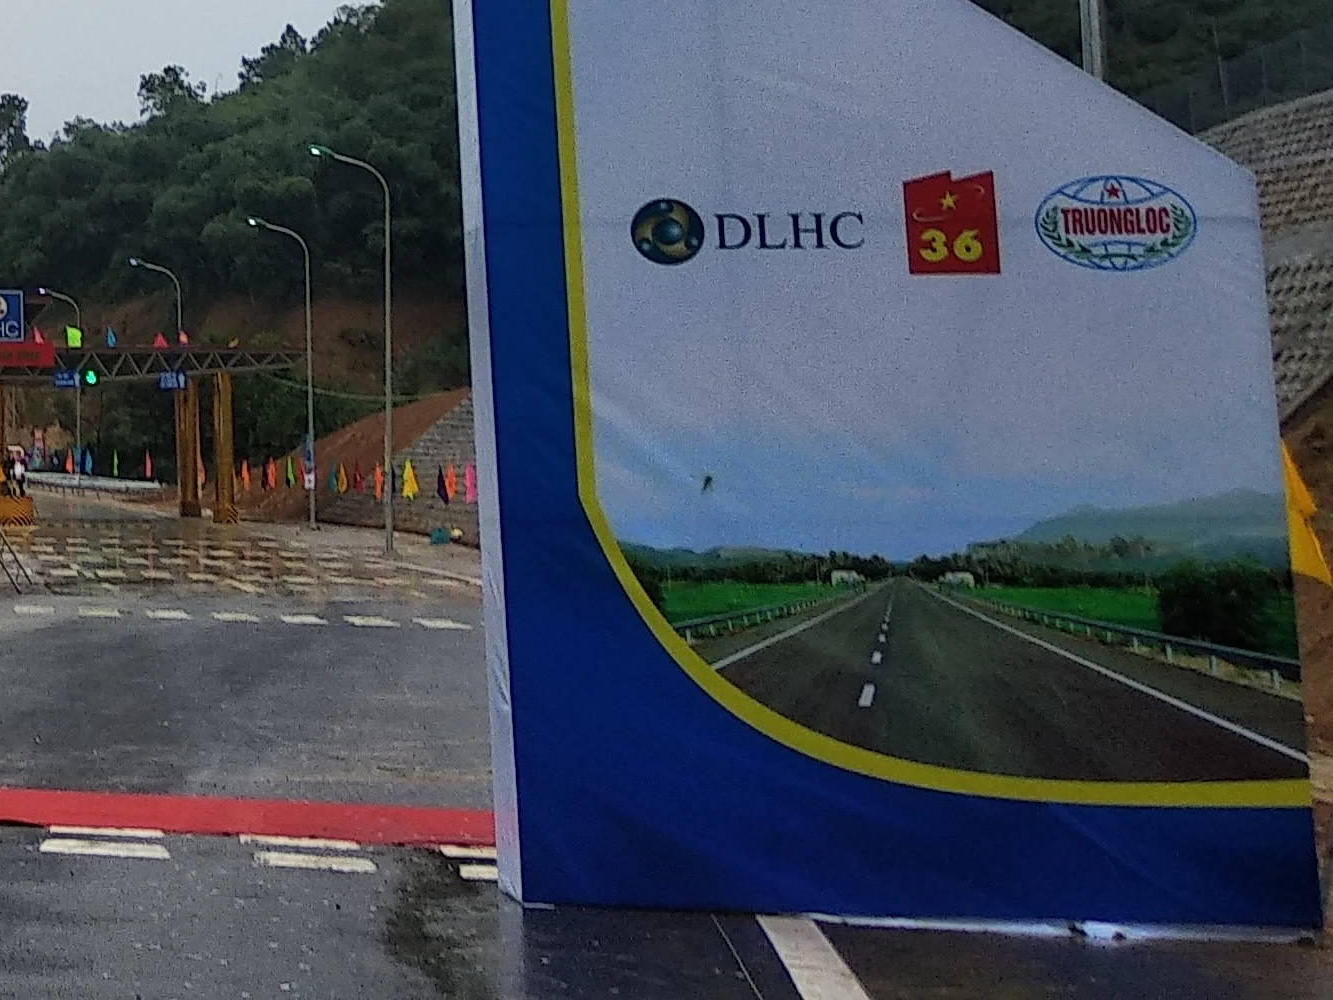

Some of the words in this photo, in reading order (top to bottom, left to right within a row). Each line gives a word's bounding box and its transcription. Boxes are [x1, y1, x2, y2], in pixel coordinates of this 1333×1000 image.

[715, 211, 866, 252] DLHC
[1060, 205, 1171, 236] TRUONGLOC
[918, 228, 984, 264] 36
